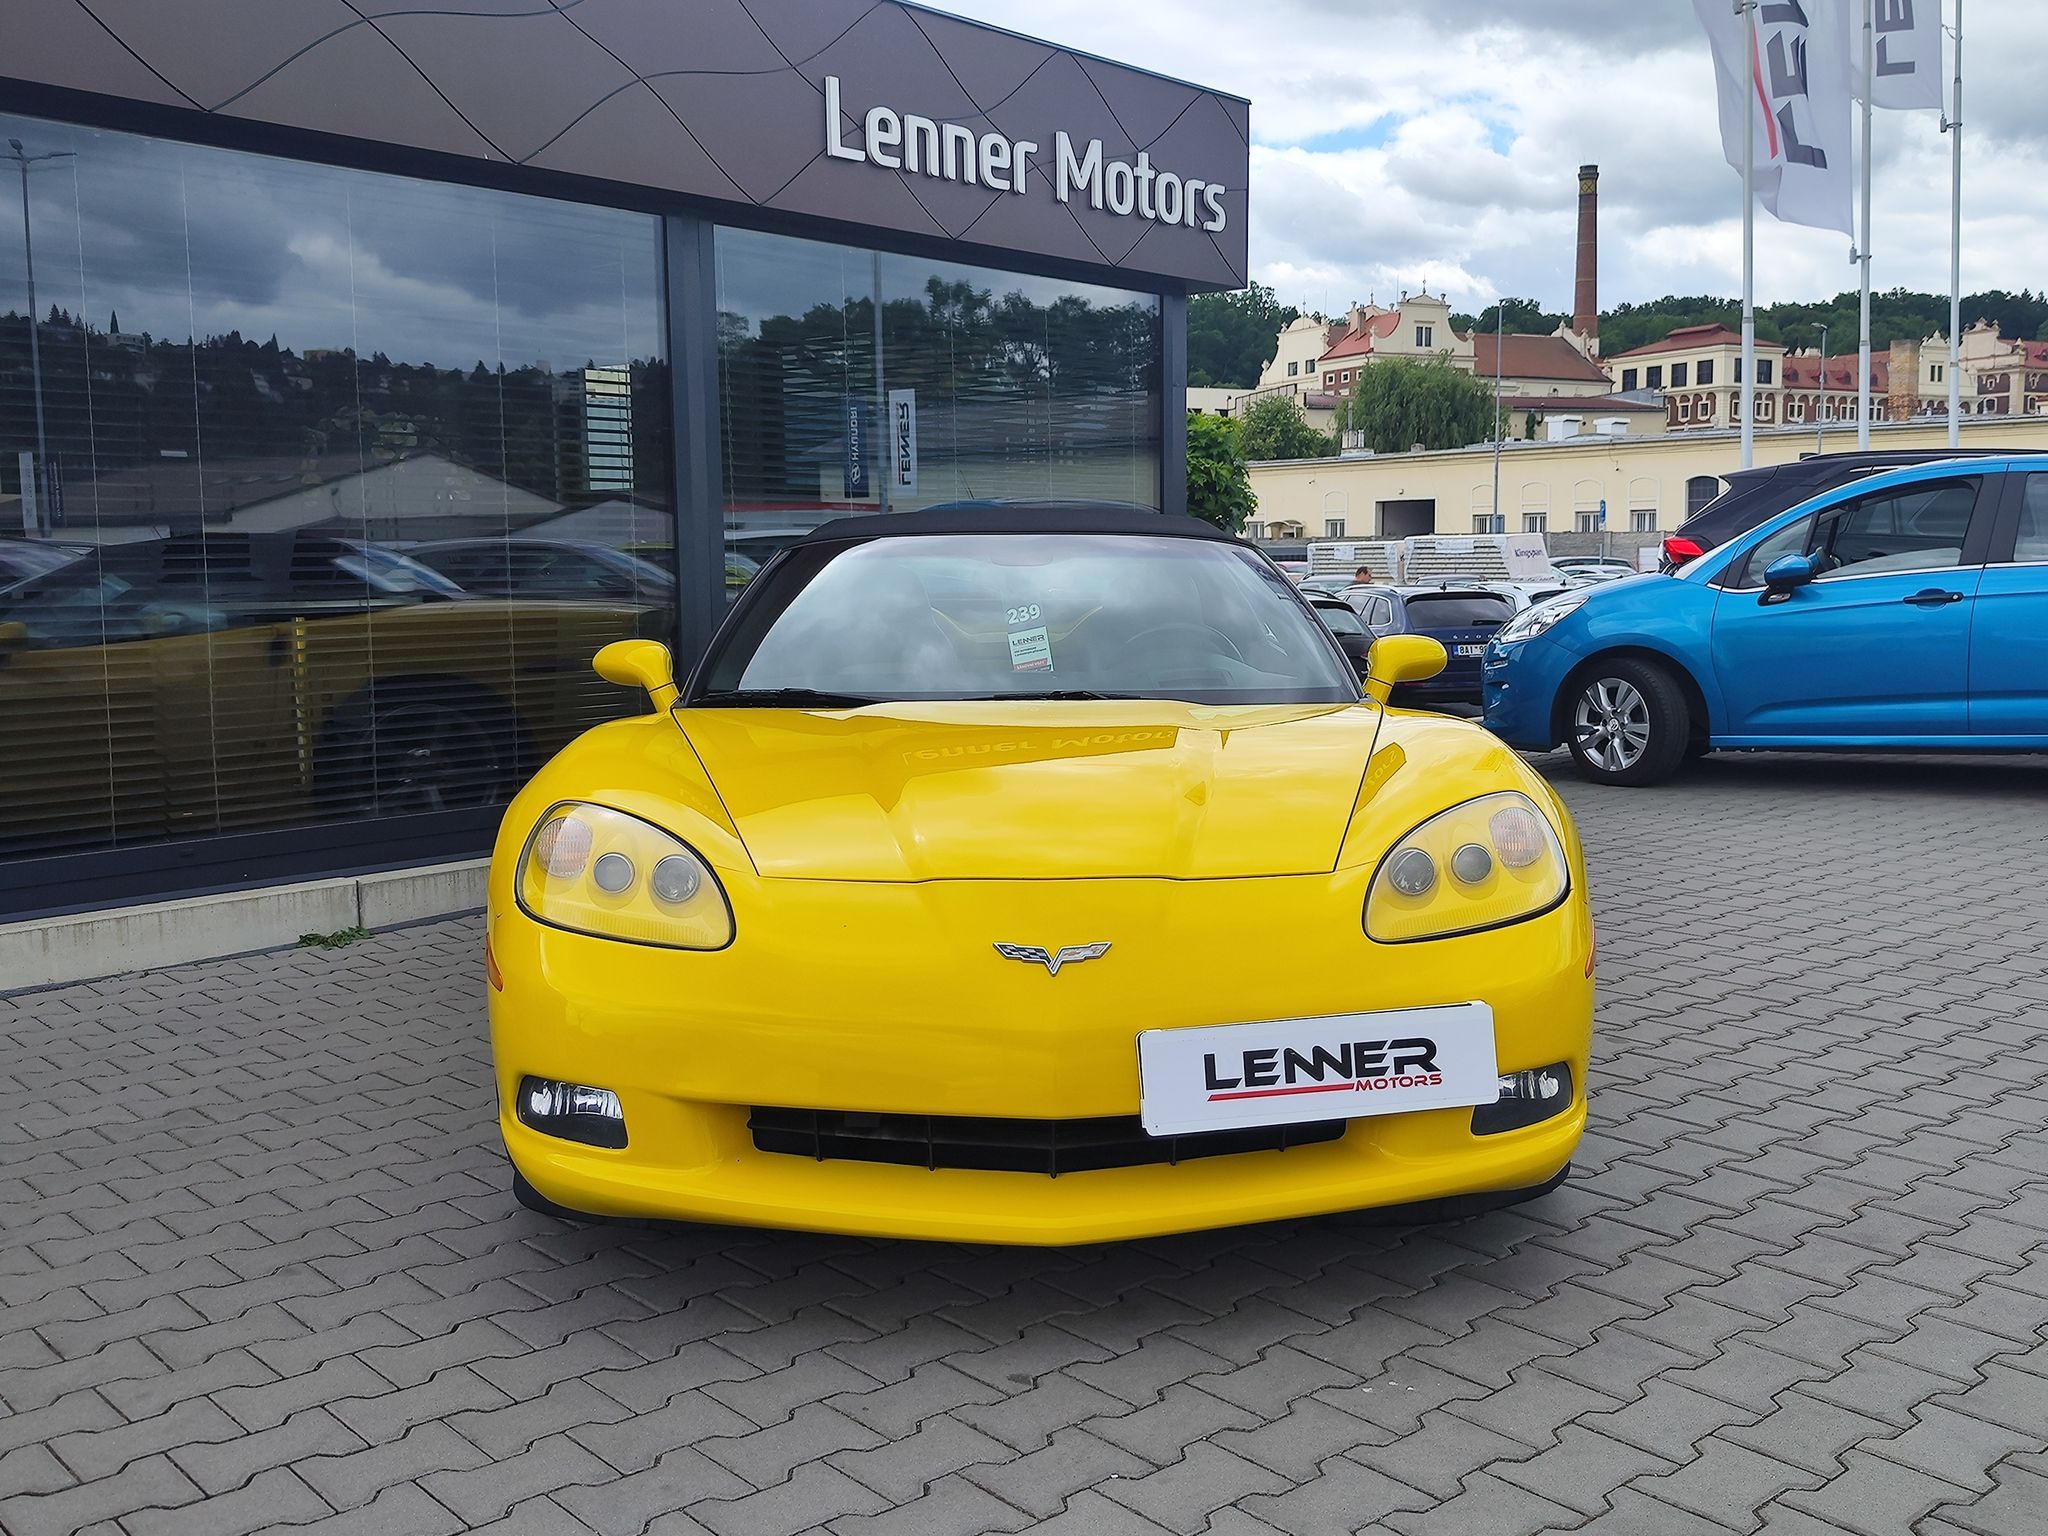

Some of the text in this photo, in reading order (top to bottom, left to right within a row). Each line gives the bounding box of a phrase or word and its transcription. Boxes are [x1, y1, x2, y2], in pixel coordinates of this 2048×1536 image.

[823, 75, 1227, 233] Lenner Motors
[1006, 603, 1041, 625] 239
[1012, 634, 1046, 646] LENNER
[1203, 1037, 1441, 1091] LENNER
[1354, 1073, 1443, 1092] MOTORS
